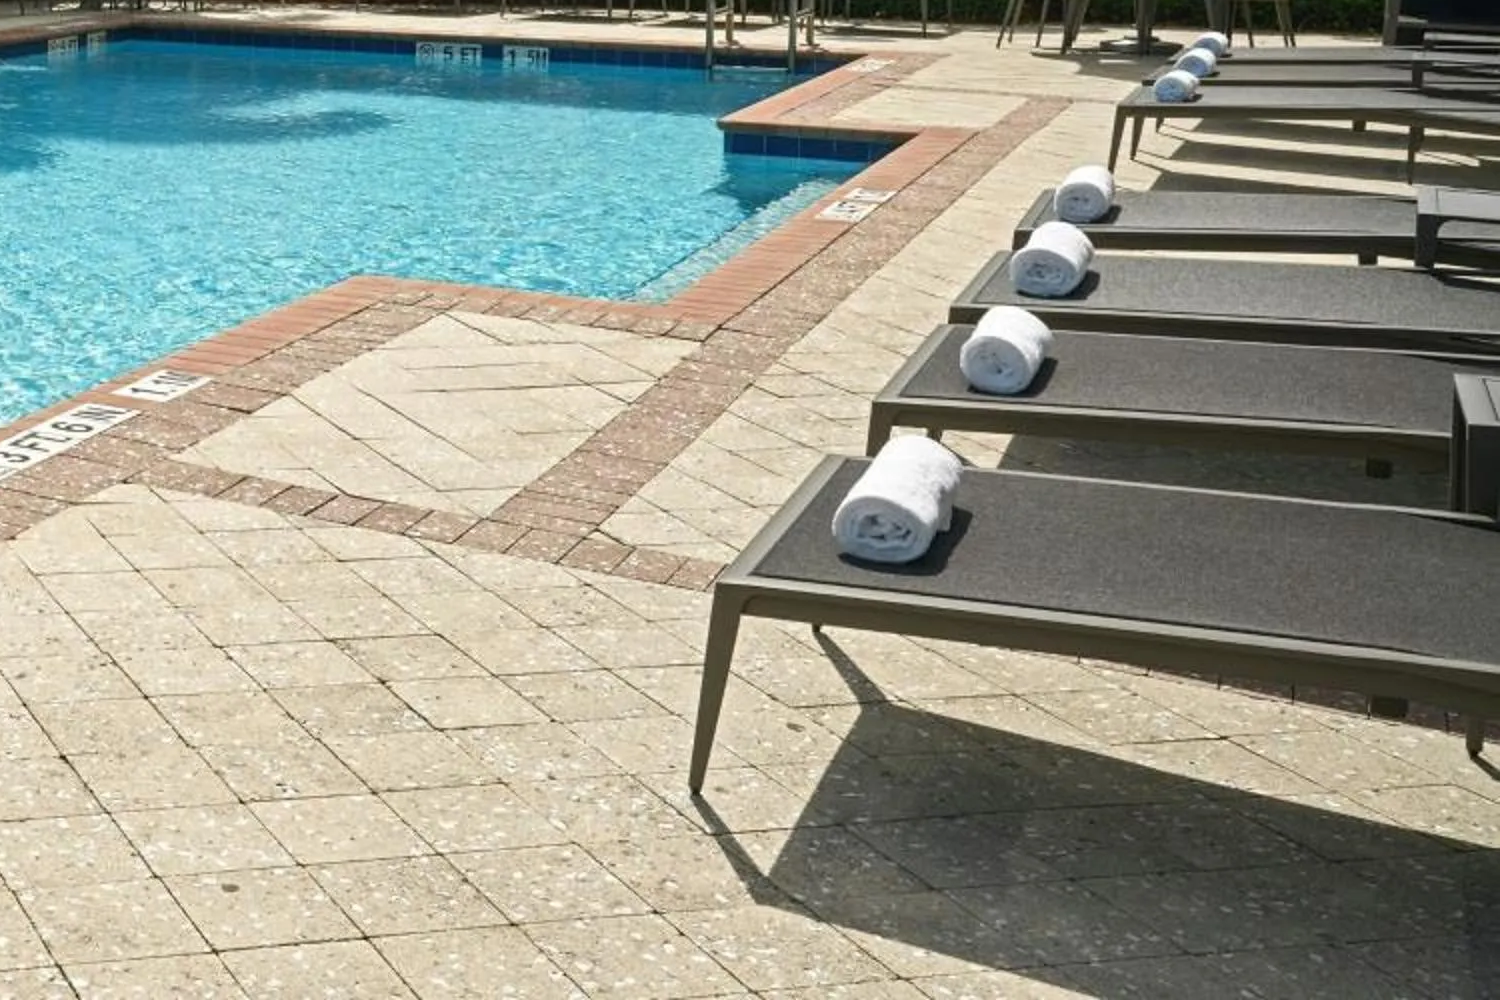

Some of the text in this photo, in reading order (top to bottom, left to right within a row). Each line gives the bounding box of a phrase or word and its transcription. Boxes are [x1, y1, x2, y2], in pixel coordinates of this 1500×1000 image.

[69, 404, 128, 424] IN
[51, 420, 94, 435] 6
[8, 430, 61, 454] FT
